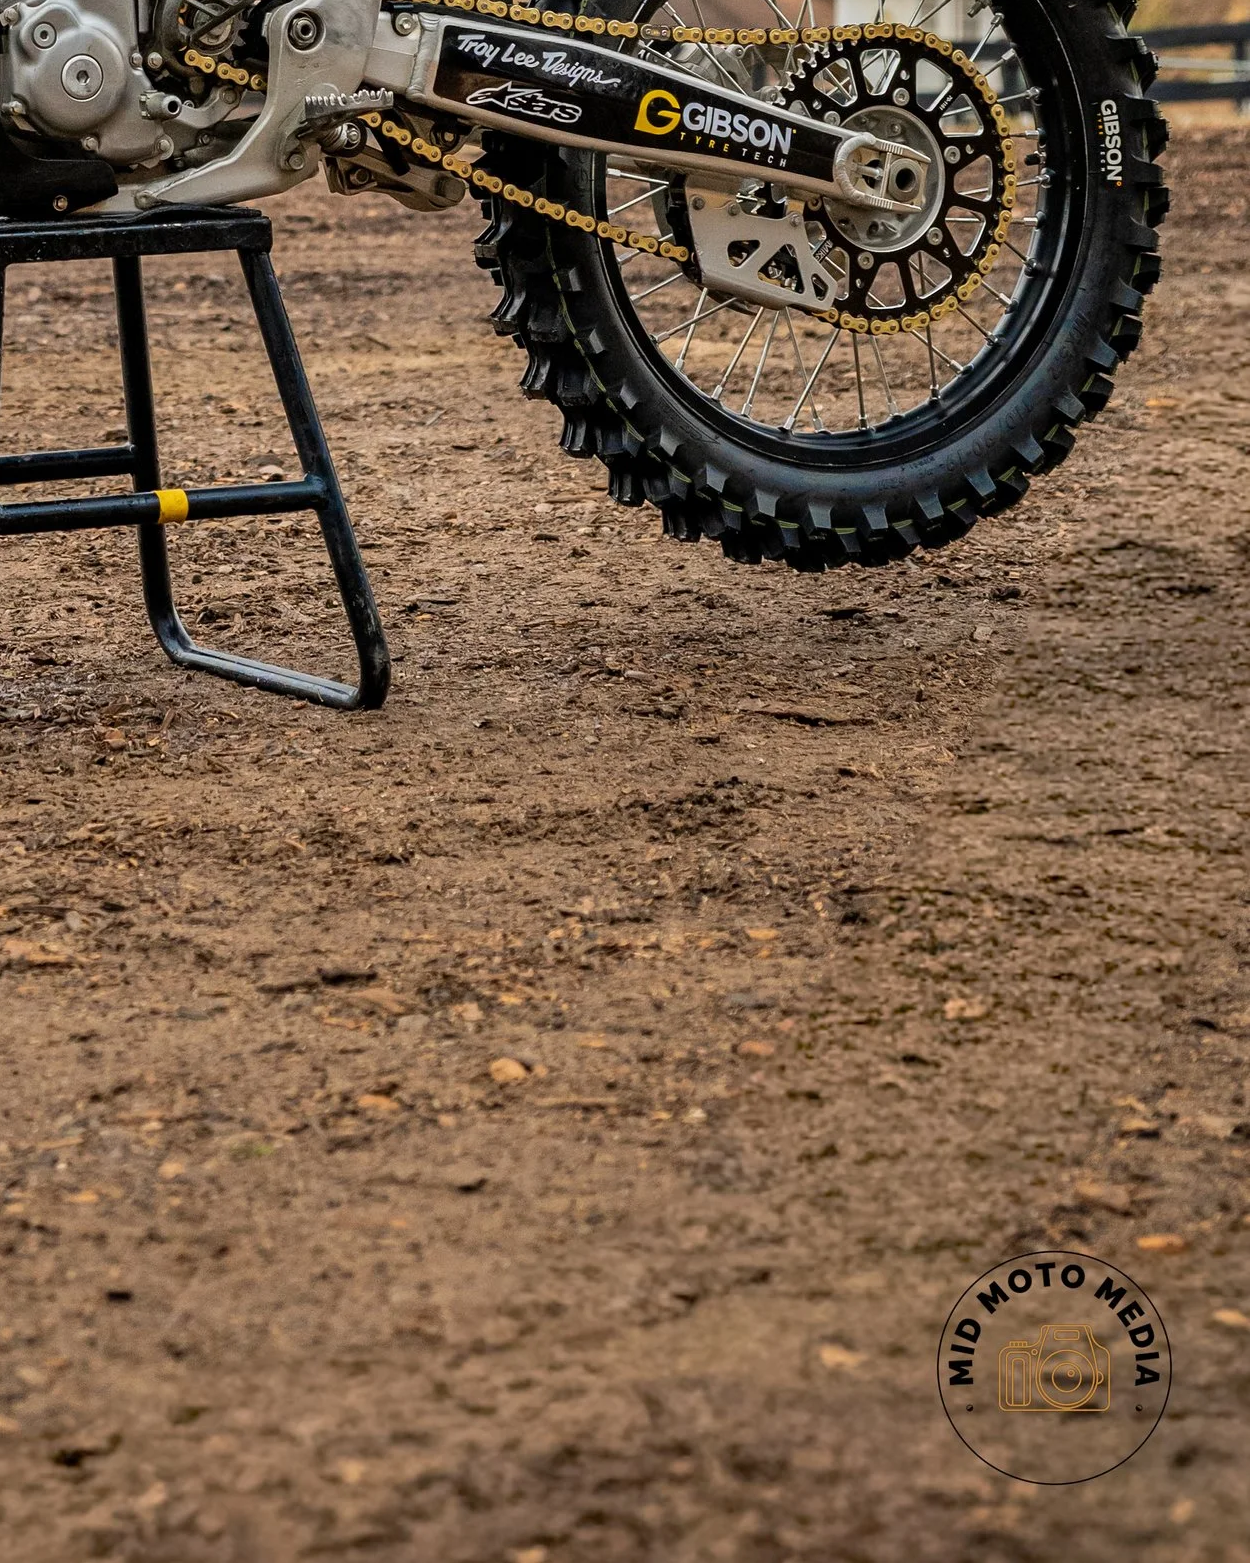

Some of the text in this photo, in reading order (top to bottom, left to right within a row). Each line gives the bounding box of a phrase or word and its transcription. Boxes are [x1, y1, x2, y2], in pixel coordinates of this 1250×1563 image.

[458, 34, 622, 88] Troy Lee Designs
[680, 132, 787, 168] TYRE TECH
[682, 102, 793, 155] GIBSON
[1100, 99, 1123, 181] GIBSON
